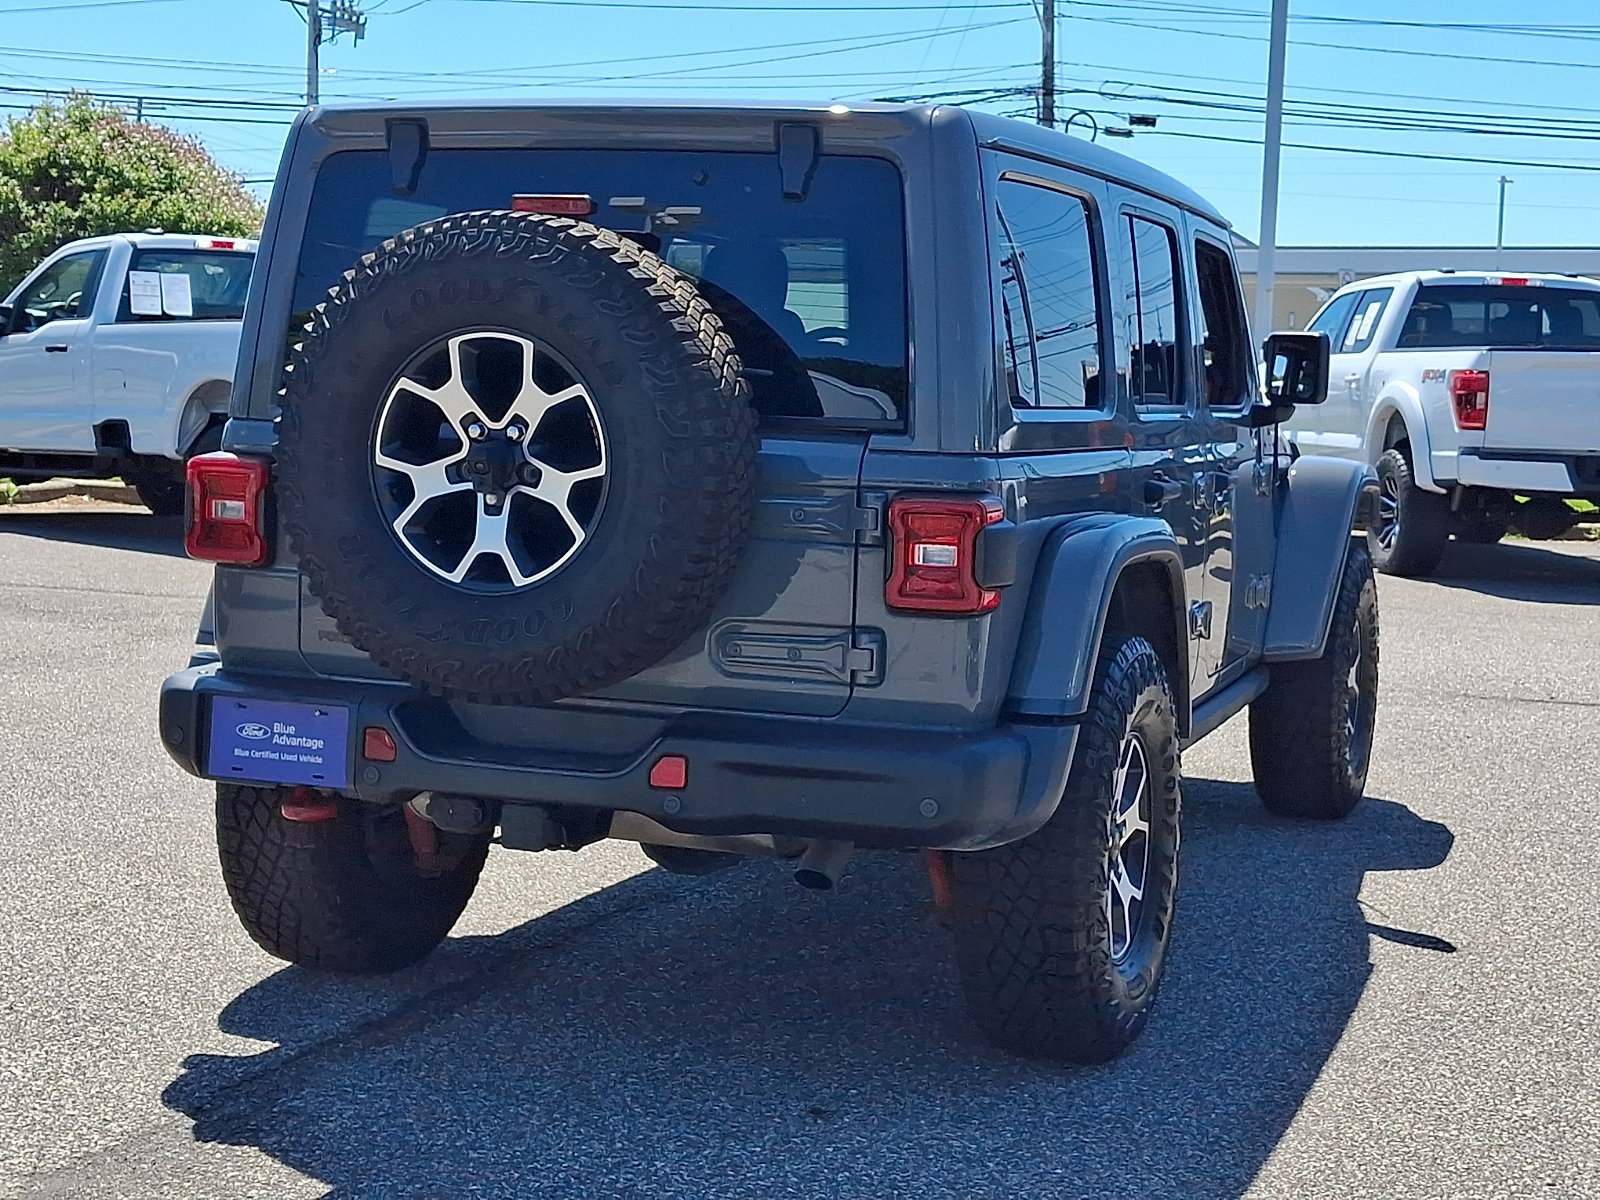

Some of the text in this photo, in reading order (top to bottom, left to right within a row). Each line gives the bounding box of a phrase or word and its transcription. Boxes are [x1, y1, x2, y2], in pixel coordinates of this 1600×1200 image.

[273, 722, 296, 734] Blue
[272, 734, 324, 750] Advantage
[234, 747, 323, 764] Blue Certified Used Vehicle
